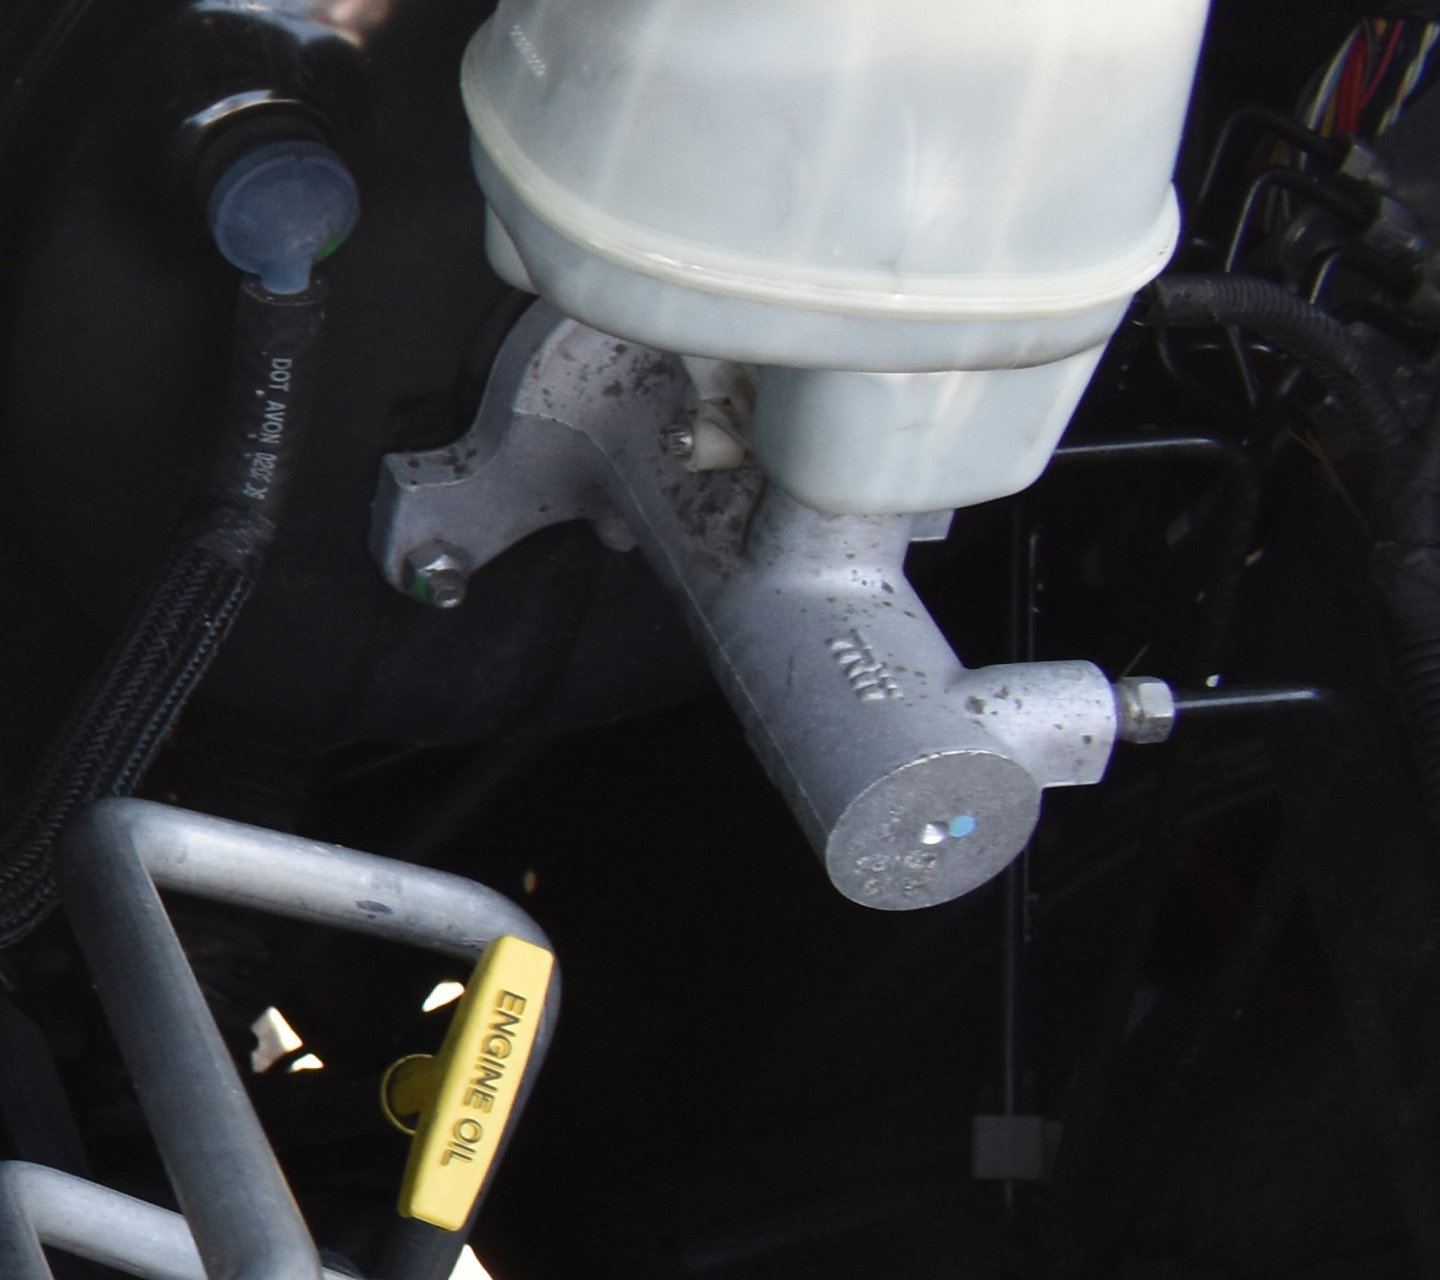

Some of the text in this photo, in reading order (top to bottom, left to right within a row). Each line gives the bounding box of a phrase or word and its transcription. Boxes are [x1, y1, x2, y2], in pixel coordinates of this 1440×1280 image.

[267, 357, 293, 393] DOT
[258, 399, 287, 445] AVON
[439, 988, 528, 1168] ENGINE OIL
